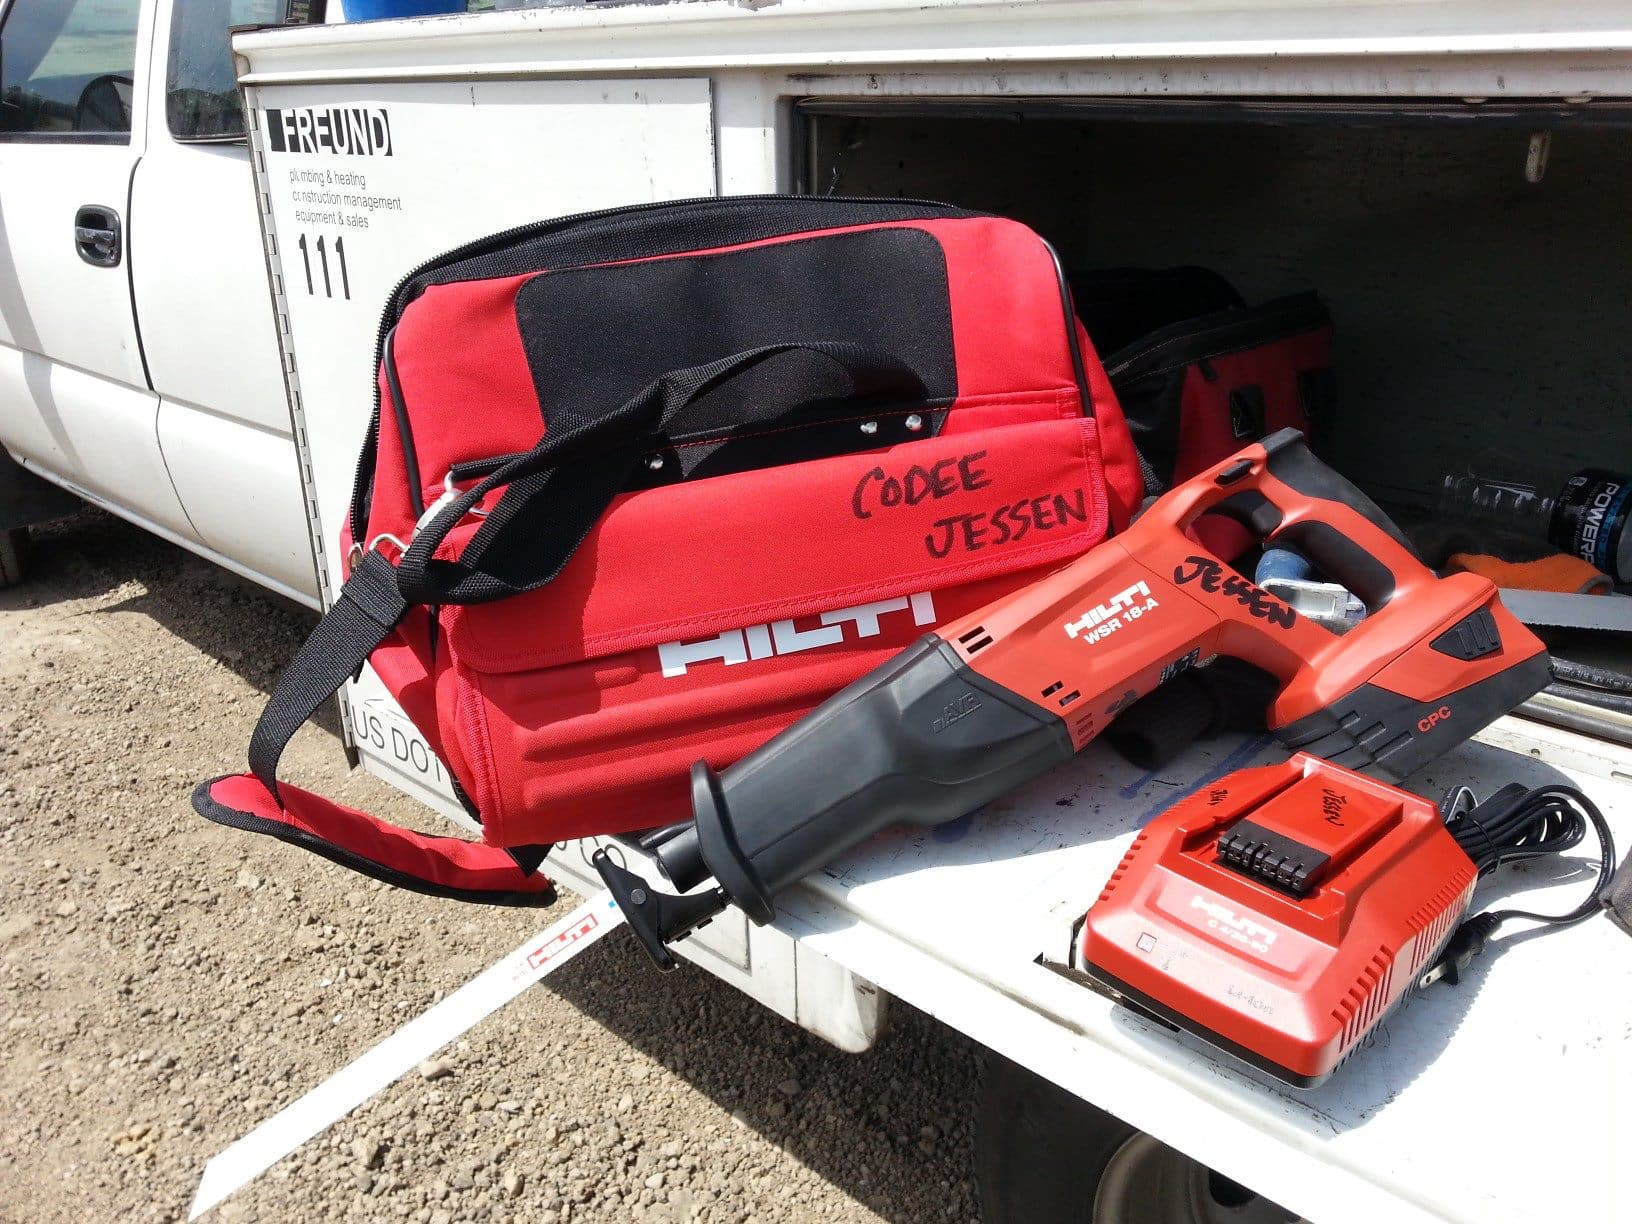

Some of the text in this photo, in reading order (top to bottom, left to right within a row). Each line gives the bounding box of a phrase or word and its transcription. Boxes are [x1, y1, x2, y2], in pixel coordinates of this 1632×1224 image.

[281, 109, 391, 156] FREUND
[326, 169, 332, 184] &
[334, 170, 366, 190] heating
[343, 194, 402, 211] management
[295, 208, 369, 228] equipment & sales
[299, 233, 350, 300] 111
[852, 450, 992, 519] CODEE
[925, 488, 1089, 558] JESSEN
[1063, 580, 1151, 640] HILTI
[1083, 597, 1160, 645] WSR 18-A
[658, 590, 937, 679] HILTI
[352, 704, 385, 750] US
[1417, 705, 1452, 733] CPC
